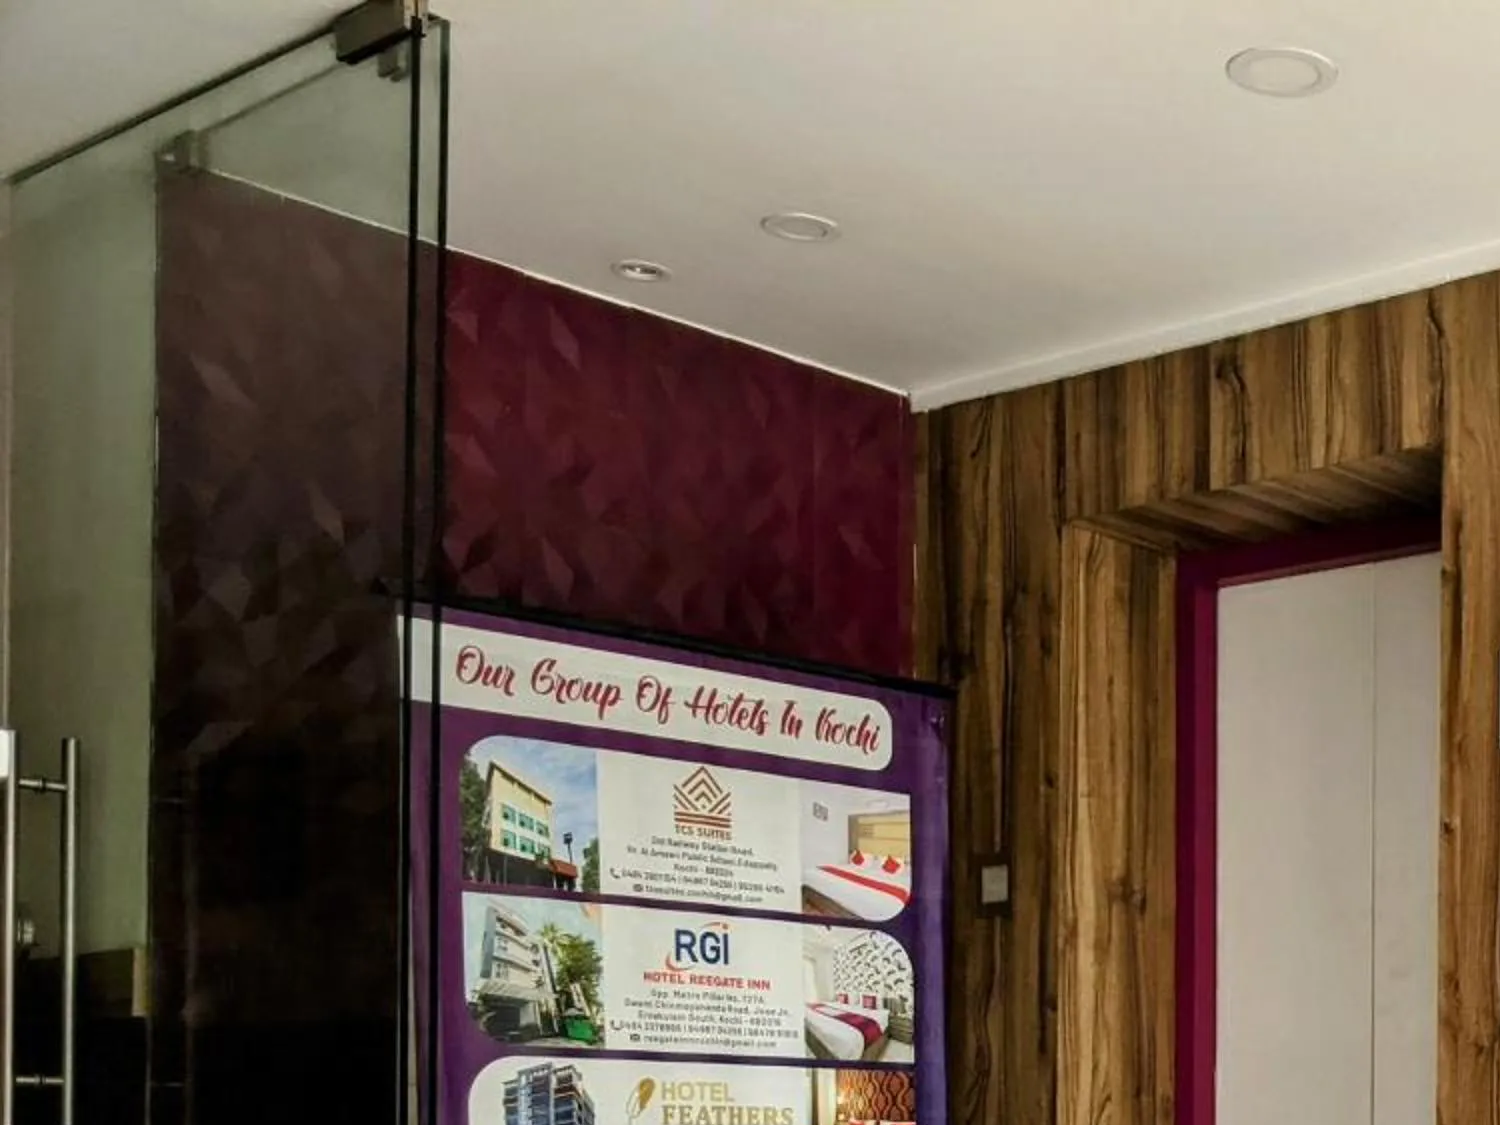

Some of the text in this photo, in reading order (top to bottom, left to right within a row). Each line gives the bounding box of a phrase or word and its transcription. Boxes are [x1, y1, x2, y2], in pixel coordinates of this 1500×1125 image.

[456, 645, 880, 755] Our Group Of Hotels In Kochi
[697, 827, 732, 841] SUITES
[643, 971, 770, 990] HOTEL REEGATE INN
[661, 1081, 735, 1102] HOTEL
